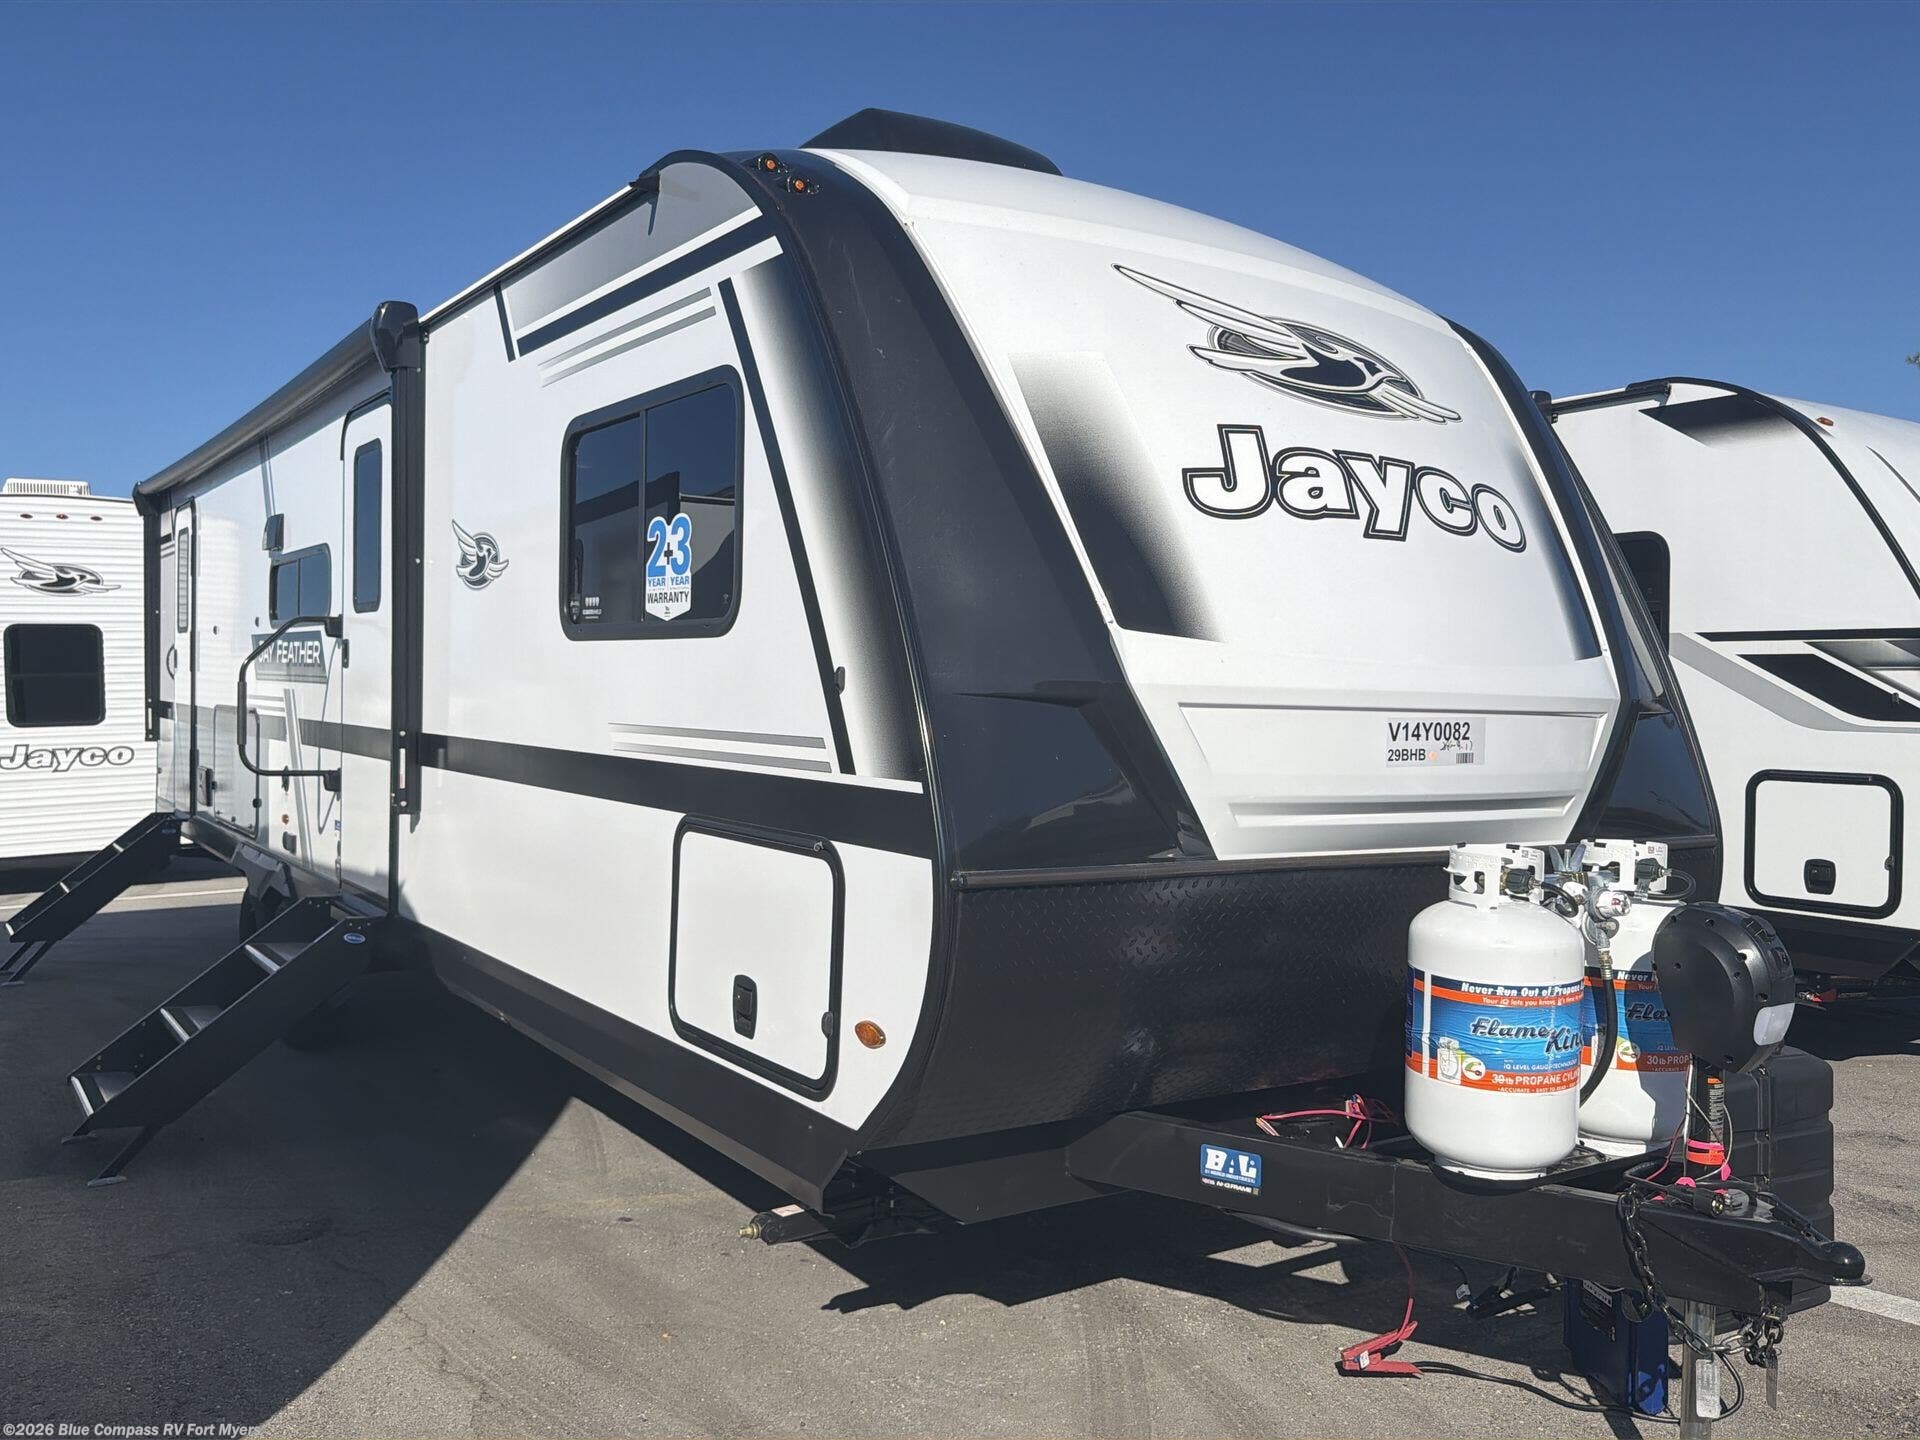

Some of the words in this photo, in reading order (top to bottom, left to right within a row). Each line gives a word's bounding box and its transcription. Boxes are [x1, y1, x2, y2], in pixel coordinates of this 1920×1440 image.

[1181, 423, 1528, 553] Jayco
[648, 578, 666, 587] YEAR
[671, 576, 690, 586] YEAR
[647, 591, 690, 604] WARRANTY
[276, 640, 321, 664] FEATHER
[1388, 722, 1471, 742] V14Y0082
[0, 744, 134, 773] Jayco
[1387, 748, 1426, 762] 29BHB
[1617, 971, 1648, 981] Never
[1461, 982, 1493, 995] Never
[1496, 987, 1518, 997] Run
[1521, 987, 1539, 997] Out
[1542, 987, 1551, 997] of
[1482, 997, 1498, 1005] Your
[1471, 1016, 1551, 1039] Flame
[1513, 1063, 1530, 1071] LEVEL
[1646, 1055, 1658, 1065] 30
[1515, 1073, 1562, 1086] PROPANE
[1205, 1148, 1257, 1178] BAL
